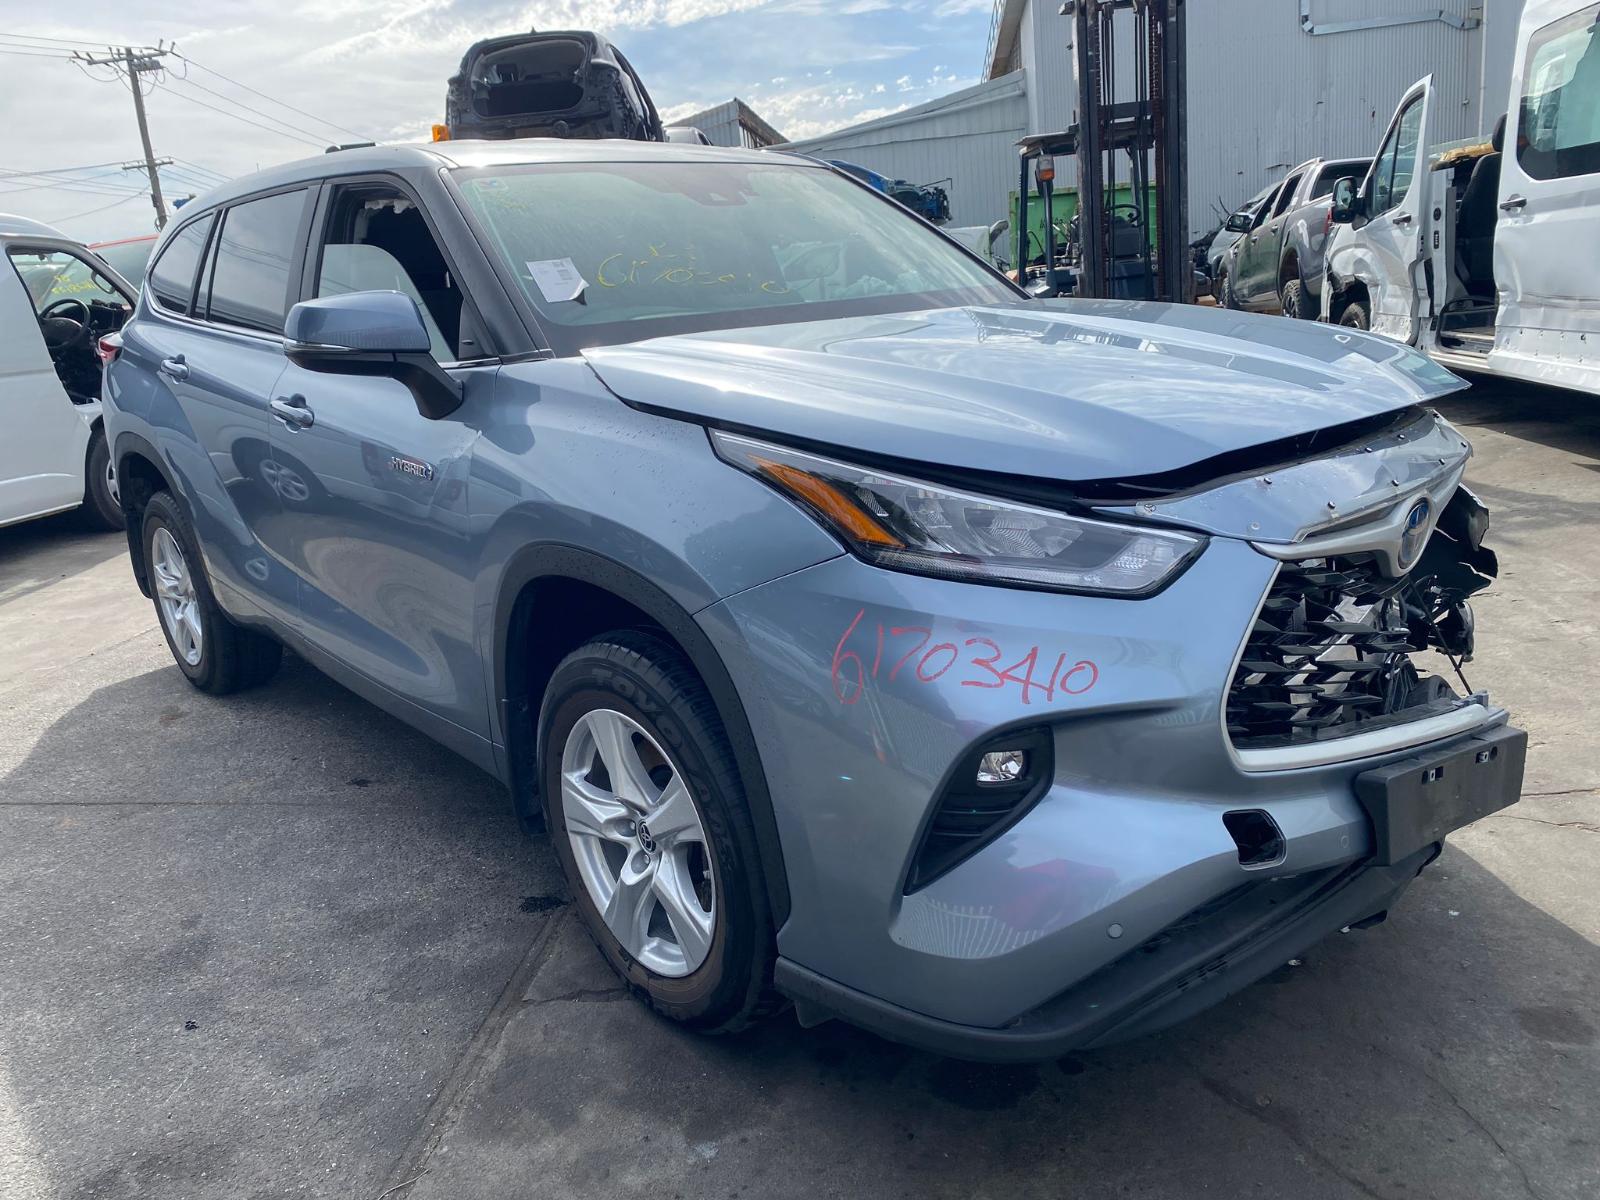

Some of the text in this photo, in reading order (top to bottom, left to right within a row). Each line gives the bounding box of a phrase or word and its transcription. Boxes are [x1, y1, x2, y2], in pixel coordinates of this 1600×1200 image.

[391, 456, 427, 478] HYBRID
[831, 608, 1099, 705] 61703410
[591, 667, 683, 747] TOYO
